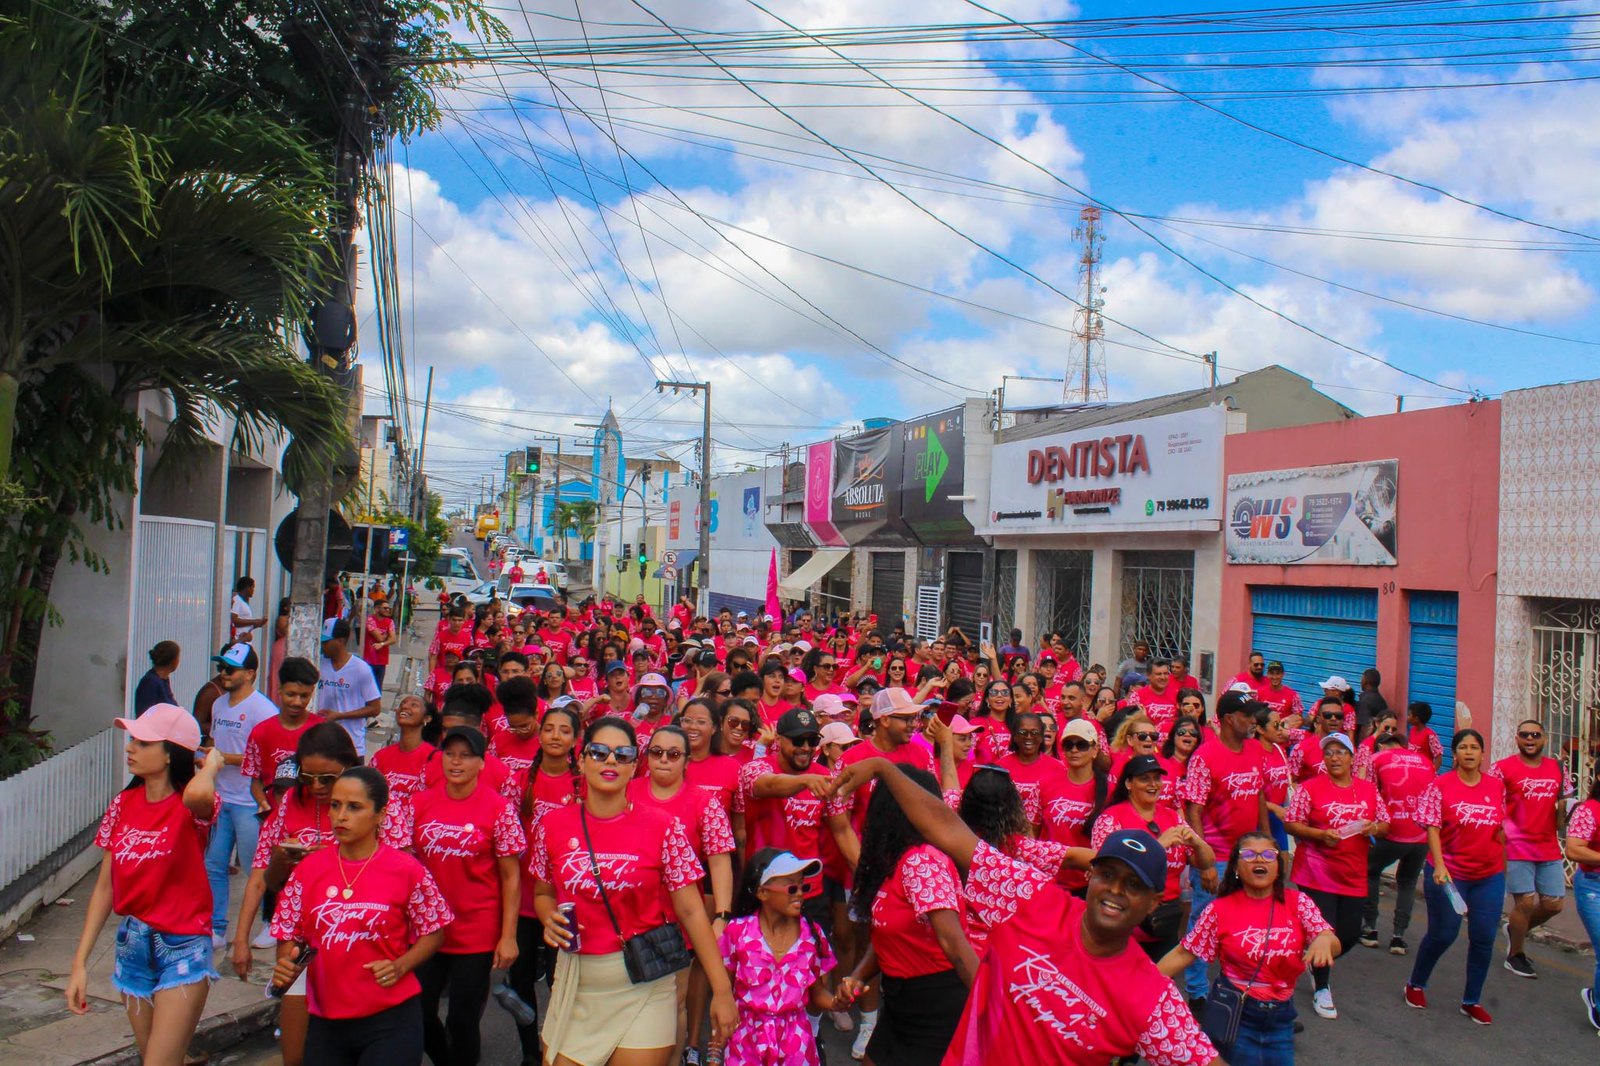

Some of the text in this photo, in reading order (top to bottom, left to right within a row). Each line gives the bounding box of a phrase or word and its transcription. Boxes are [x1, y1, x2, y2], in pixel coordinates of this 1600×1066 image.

[1028, 434, 1150, 485] DENTISTA
[843, 484, 885, 506] ABSOLUTA
[1383, 581, 1395, 596] 80
[1053, 811, 1086, 829] Ampa
[310, 898, 367, 930] Rosas
[1013, 944, 1081, 1007] Rosas
